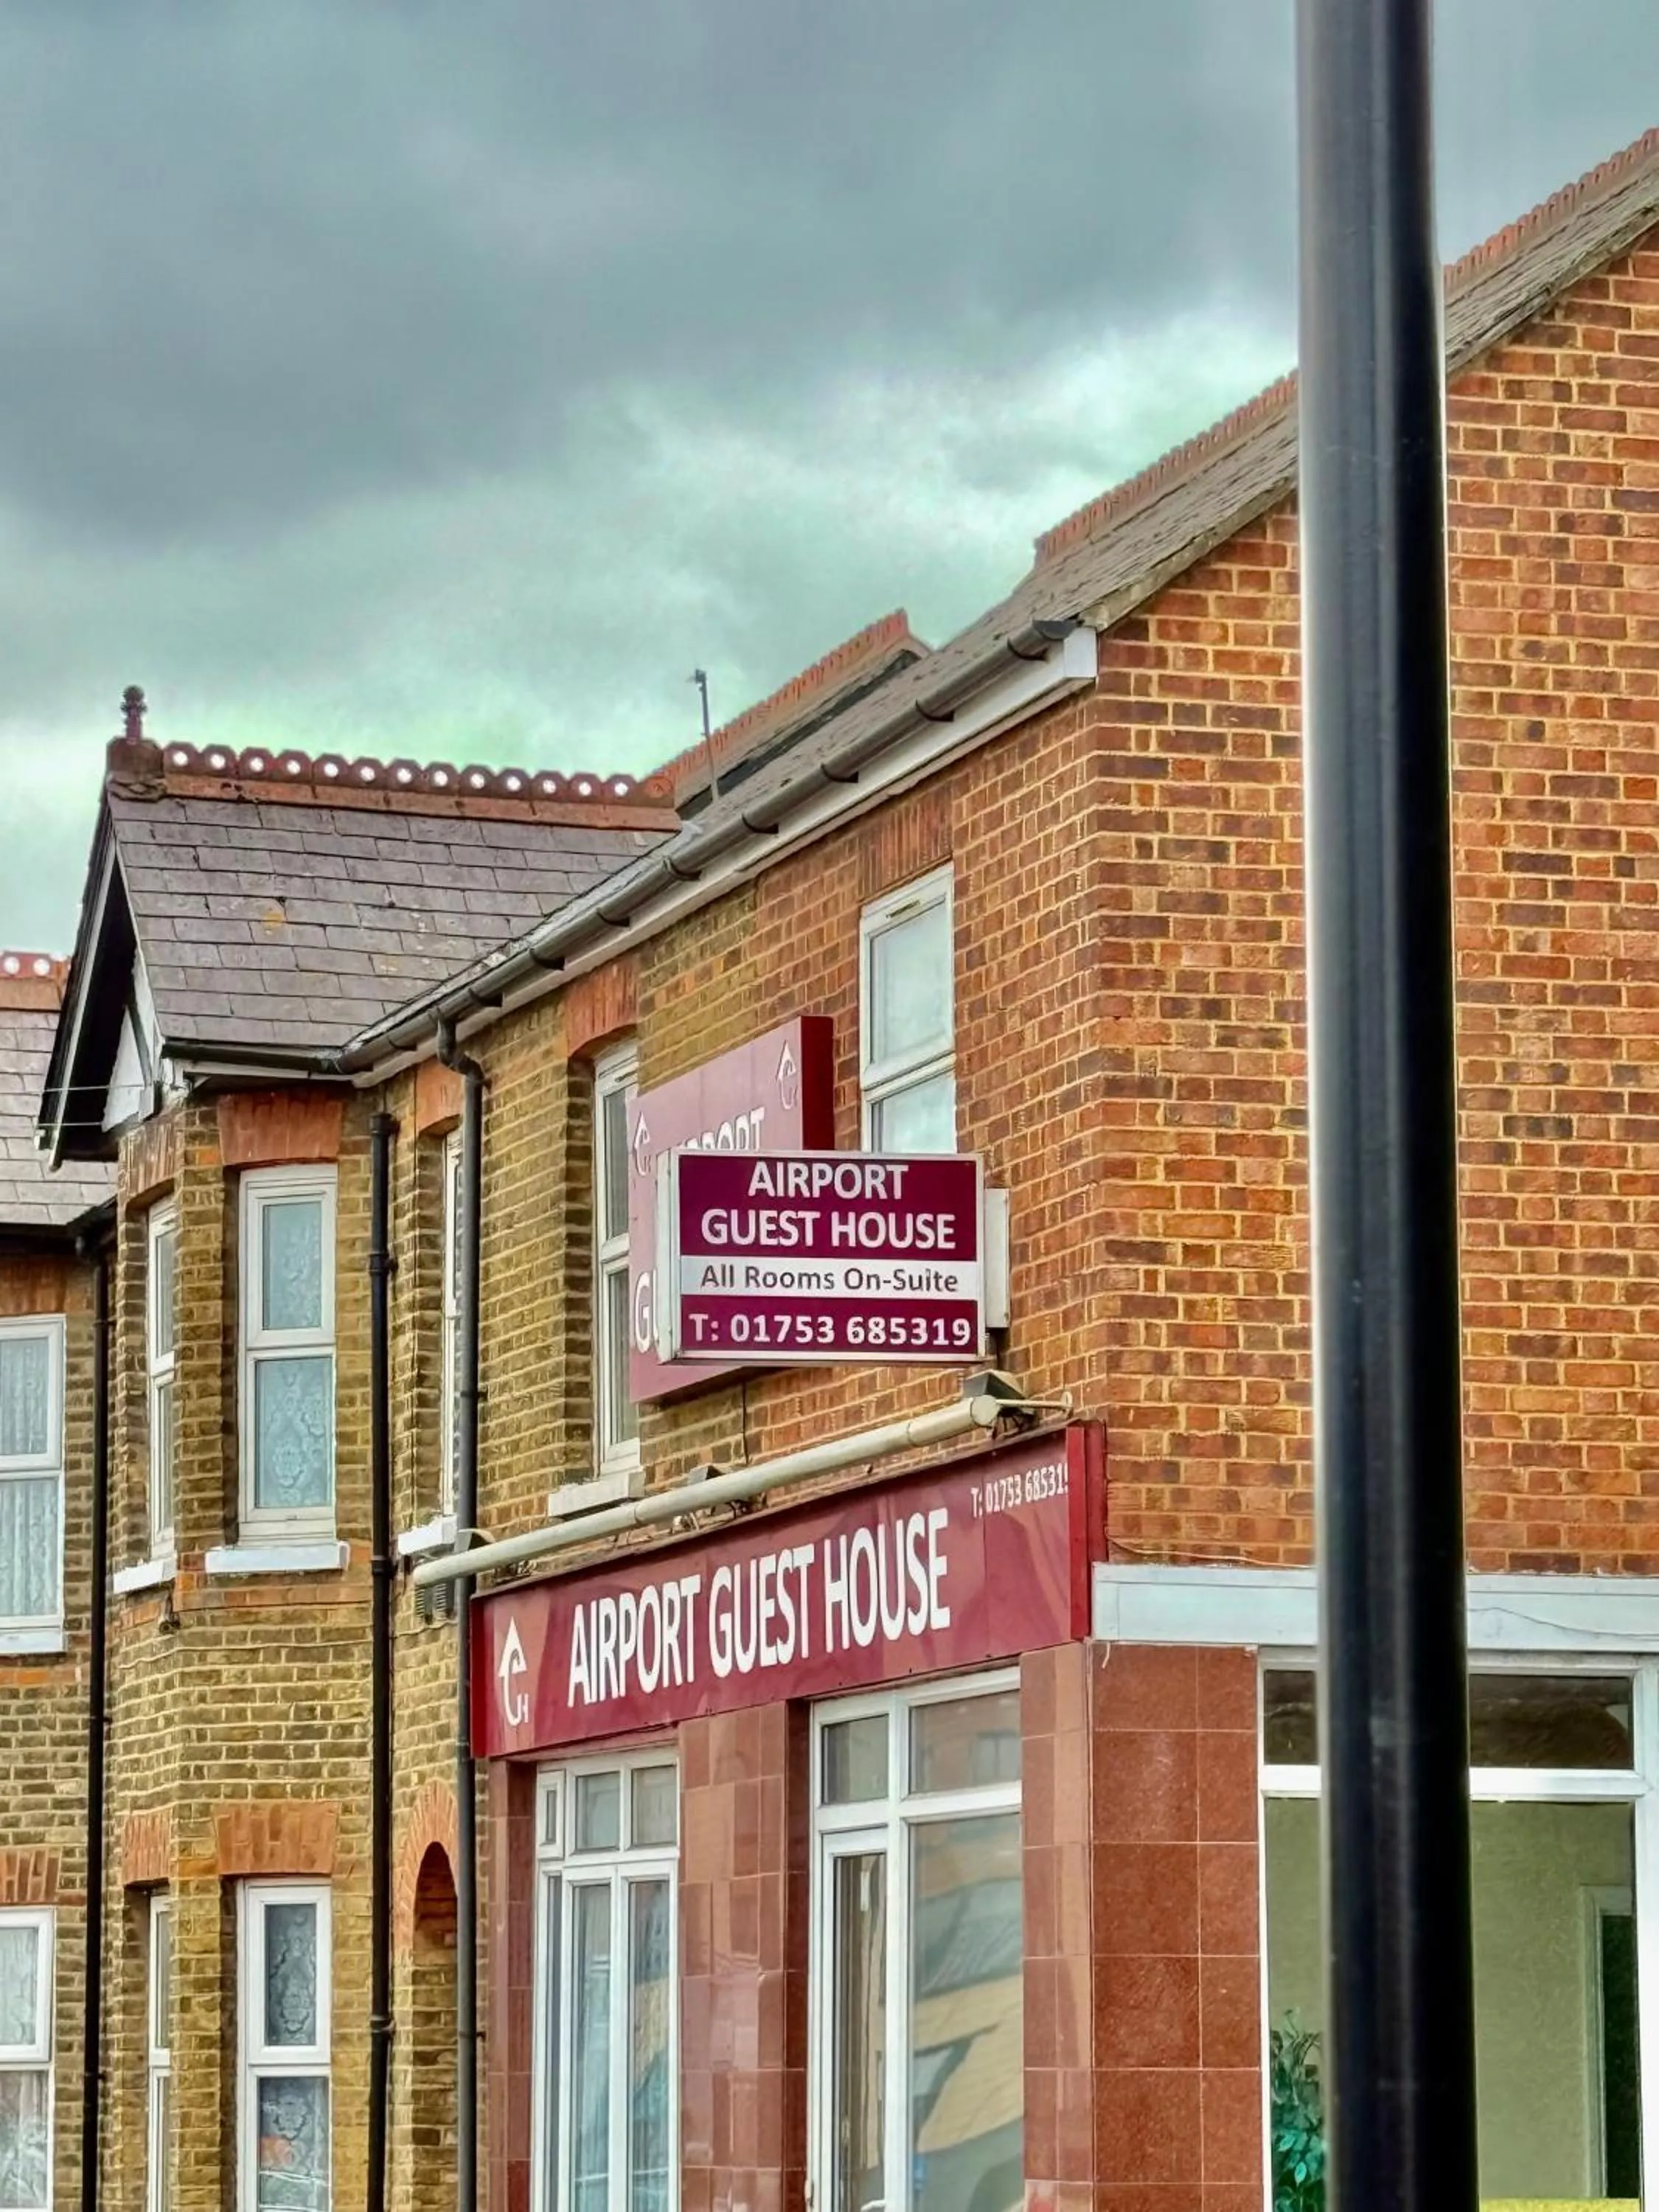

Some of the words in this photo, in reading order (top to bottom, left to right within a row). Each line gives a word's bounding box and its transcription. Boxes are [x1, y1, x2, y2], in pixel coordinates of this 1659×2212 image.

[748, 1161, 908, 1199] AIRPORT
[700, 1209, 820, 1246] GUEST
[831, 1211, 956, 1249] HOUSE
[700, 1265, 735, 1288] All
[744, 1266, 835, 1289] Rooms
[844, 1268, 959, 1292] On-Suite
[689, 1313, 719, 1341] T:
[730, 1315, 835, 1343] 01753
[846, 1317, 970, 1346] 685319
[970, 1486, 983, 1519] T:
[985, 1474, 1021, 1513] 01753
[567, 1573, 701, 1708] AIRPORT
[709, 1543, 815, 1678] GUEST
[824, 1507, 950, 1653] HOUSE
